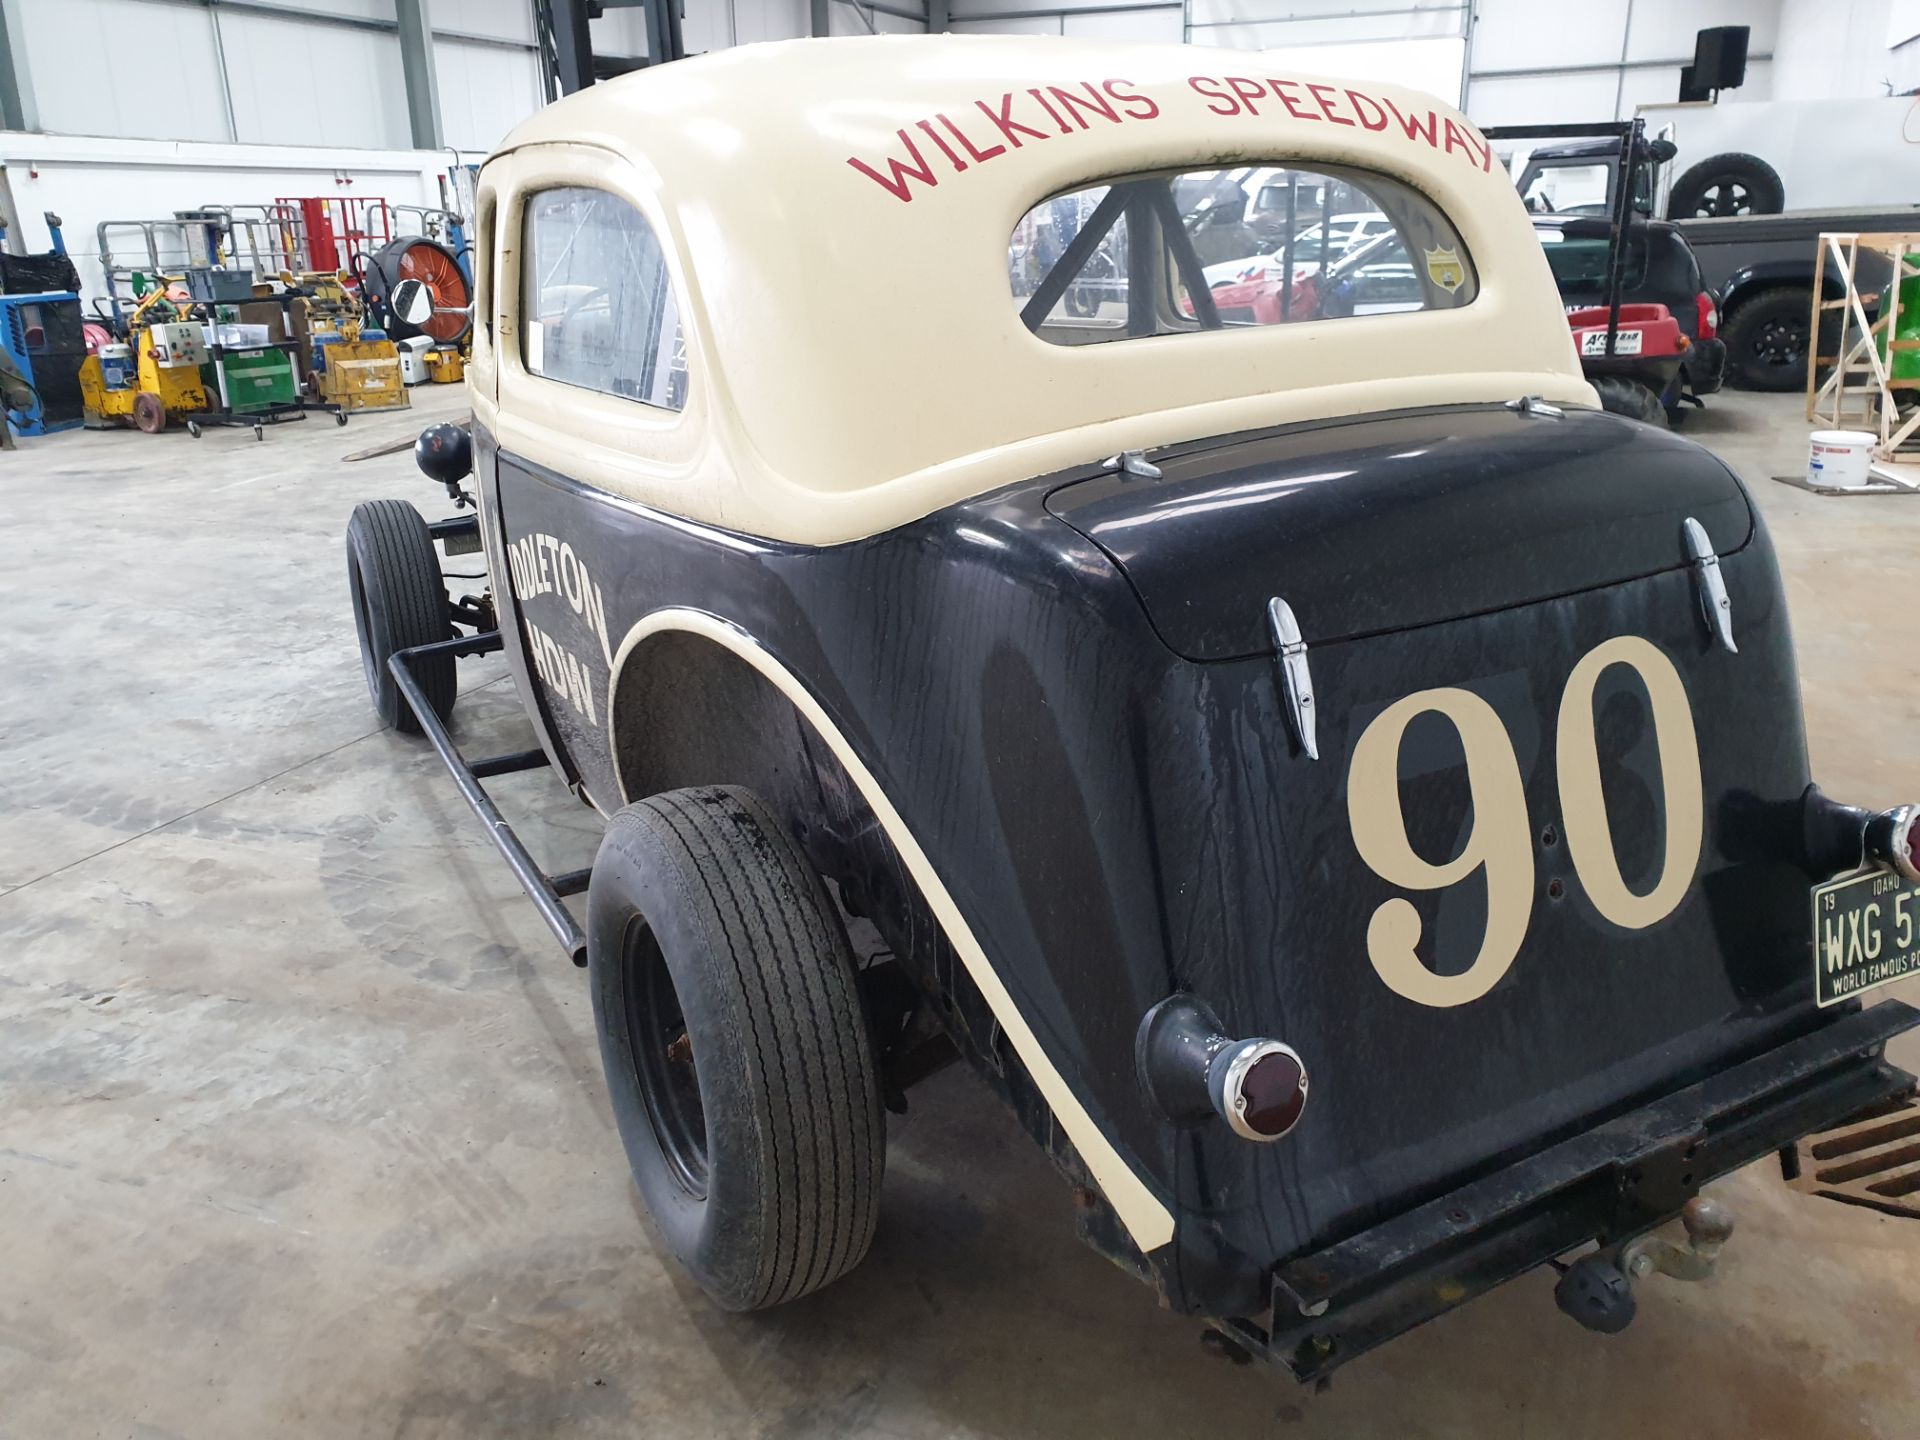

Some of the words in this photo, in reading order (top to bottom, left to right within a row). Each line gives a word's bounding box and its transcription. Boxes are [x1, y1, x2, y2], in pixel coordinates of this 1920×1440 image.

[848, 78, 1158, 203] WILKINS
[1188, 75, 1492, 175] SPEEDWAY
[1347, 635, 1704, 1009] 90
[1824, 893, 1835, 911] 19
[1873, 874, 1900, 896] IDAHO
[1826, 903, 1882, 973] WXG
[1832, 969, 1867, 995] WORLD
[1869, 955, 1908, 982] FAMOUS
